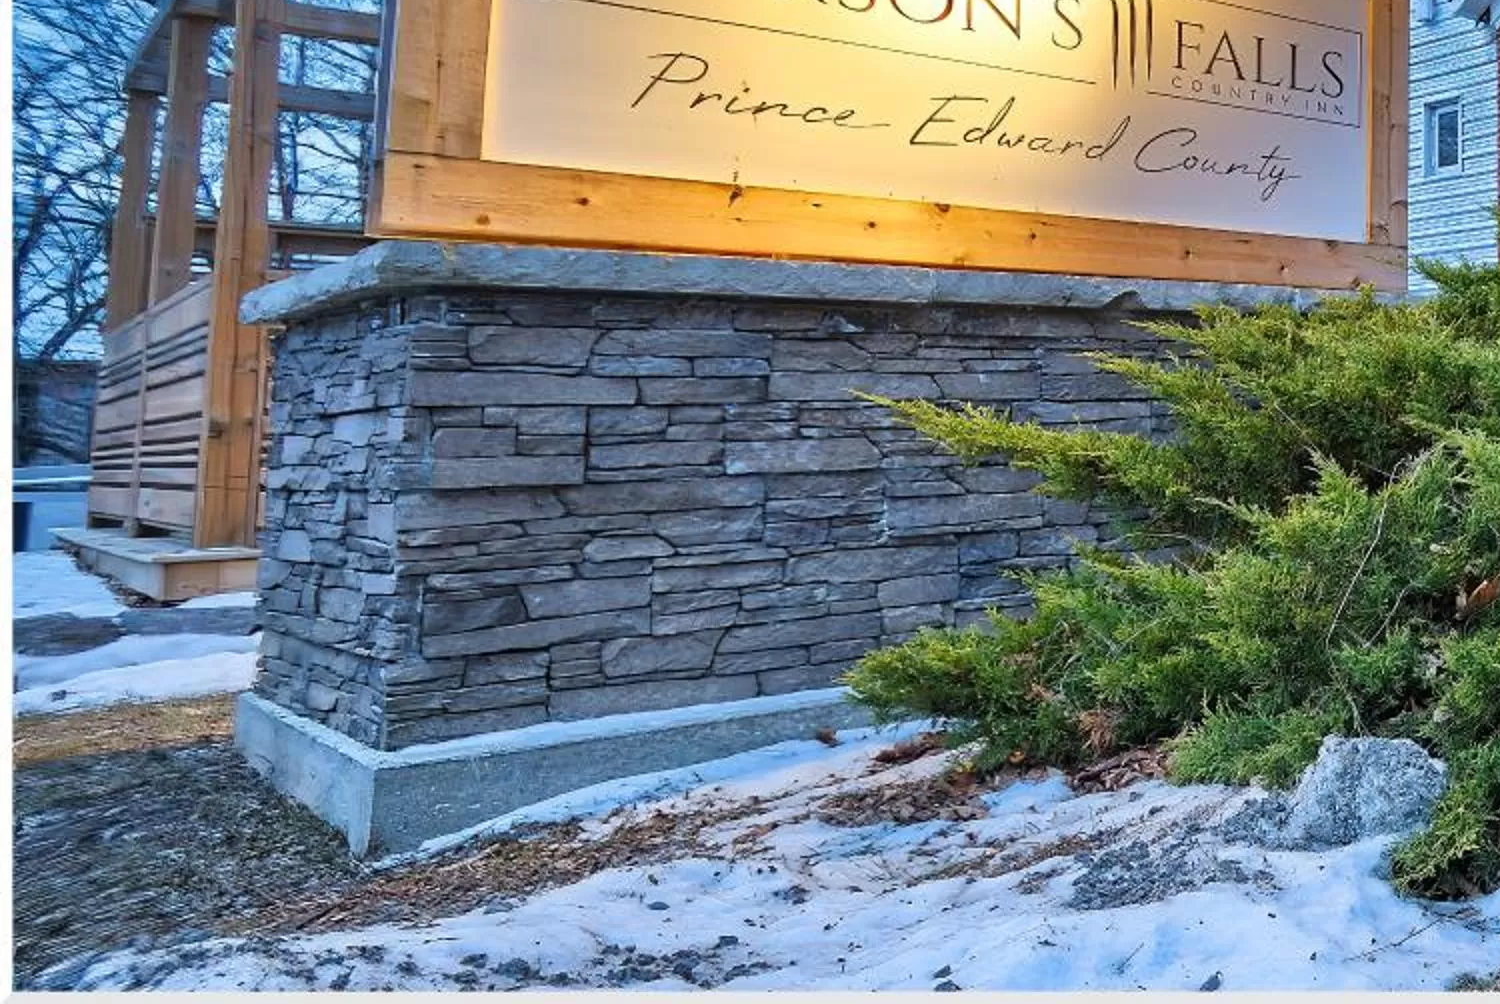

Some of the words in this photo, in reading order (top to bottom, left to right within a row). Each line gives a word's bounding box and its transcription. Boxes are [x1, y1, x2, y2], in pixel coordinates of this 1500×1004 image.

[1170, 75, 1293, 107] COUNTRY
[1303, 97, 1346, 117] INN
[1172, 19, 1345, 98] FALLS
[631, 51, 890, 129] Prince
[908, 94, 1131, 163] Edward
[1133, 126, 1301, 203] County
